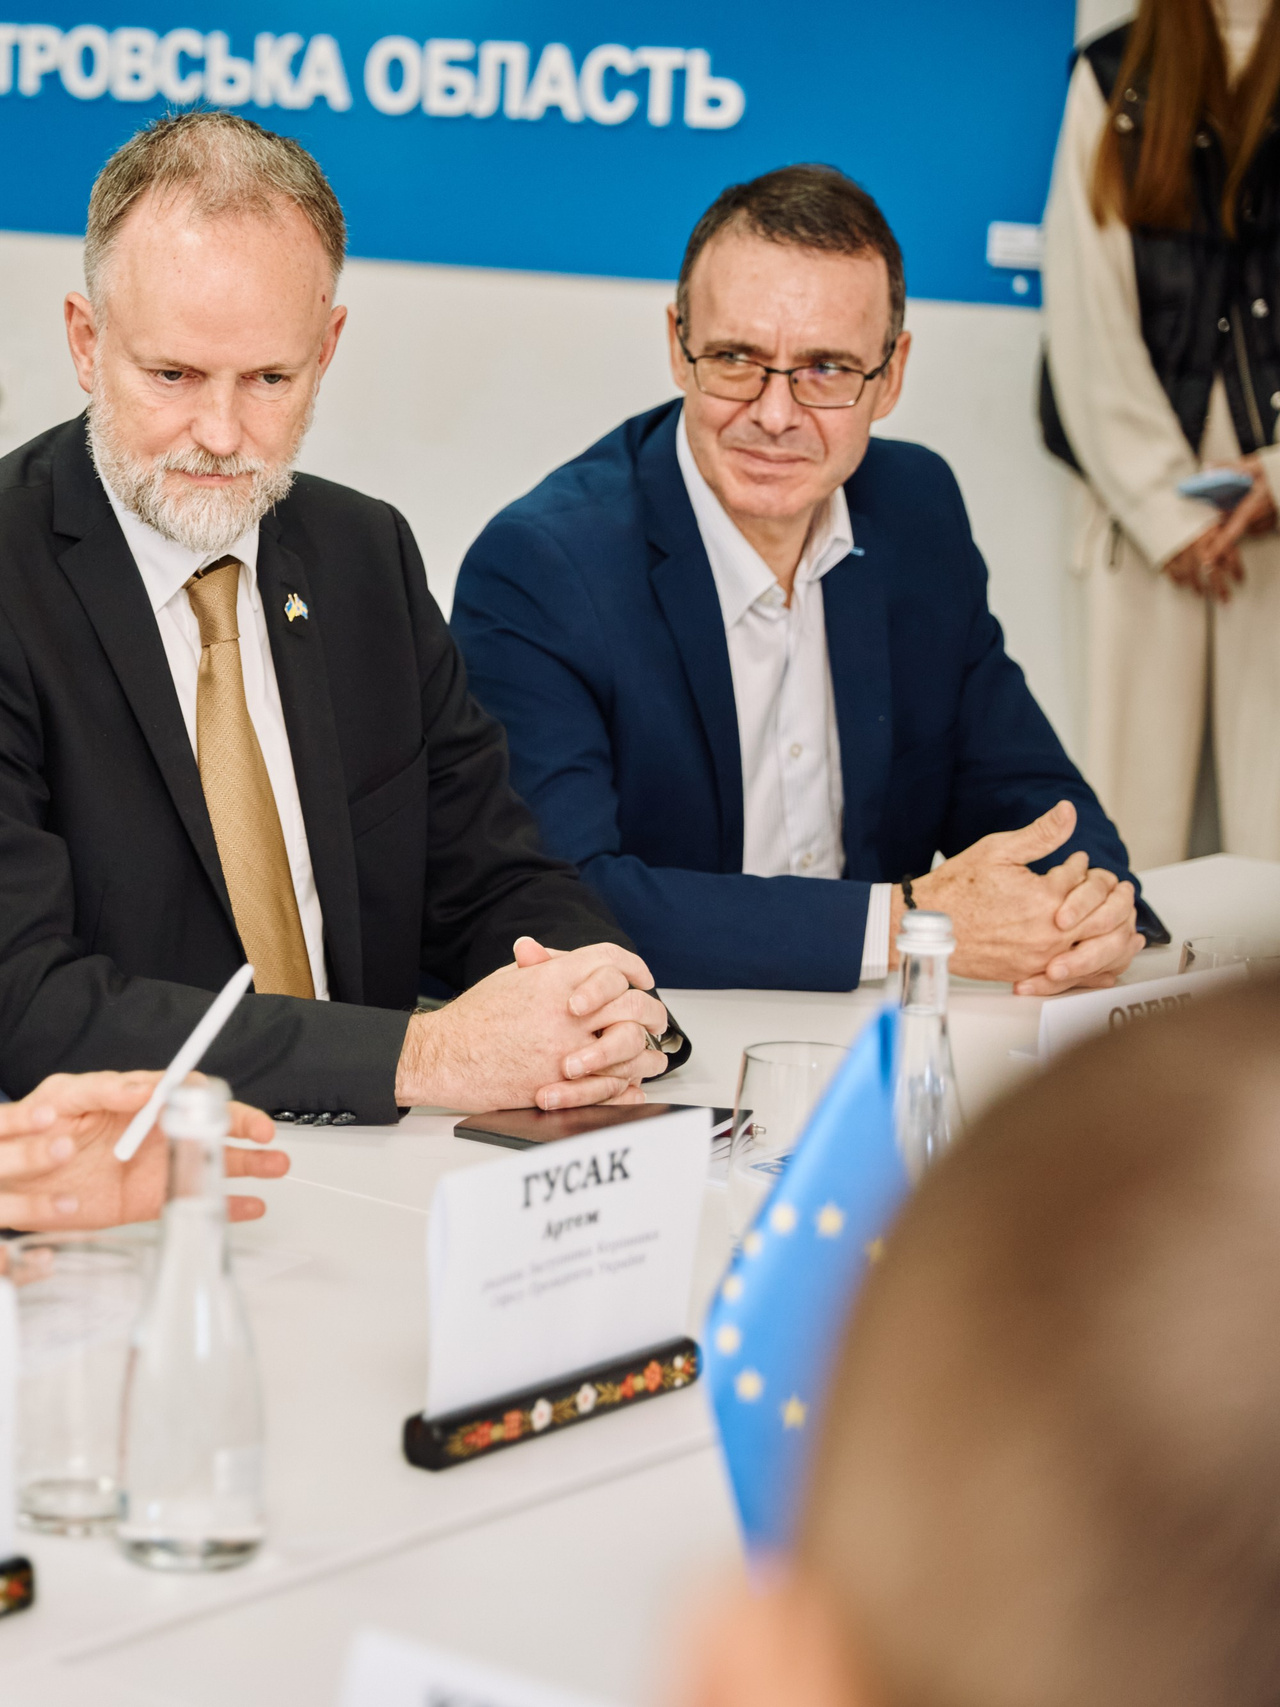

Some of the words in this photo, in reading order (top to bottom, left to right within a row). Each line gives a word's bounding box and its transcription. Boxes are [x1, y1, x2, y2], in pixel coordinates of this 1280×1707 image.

[363, 34, 746, 130] ОБЛАСТЬ
[521, 1147, 631, 1209] ГУСАК
[542, 1209, 600, 1240] Артем
